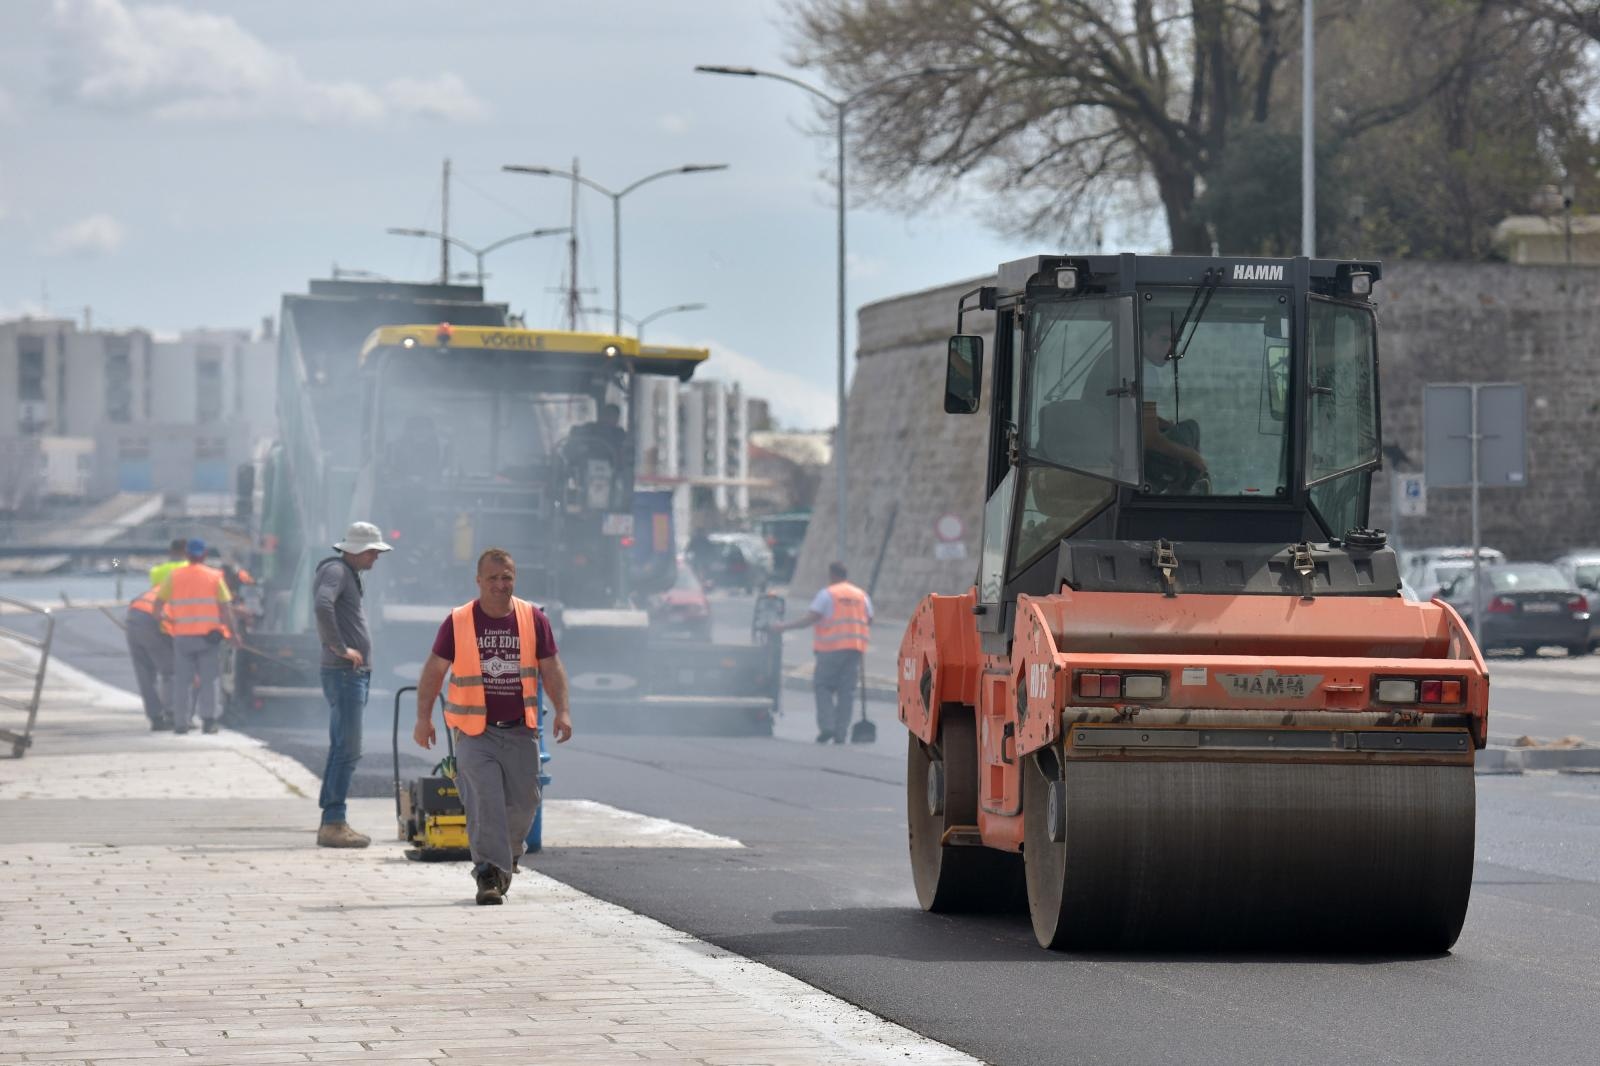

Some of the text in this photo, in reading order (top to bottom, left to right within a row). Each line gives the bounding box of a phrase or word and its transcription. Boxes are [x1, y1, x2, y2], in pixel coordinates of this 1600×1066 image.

[1233, 264, 1283, 280] HAMM
[480, 332, 545, 349] VÖGELE
[484, 628, 511, 636] Limited
[476, 635, 497, 649] AGE
[1039, 664, 1047, 699] 75
[1233, 677, 1304, 695] HAMM
